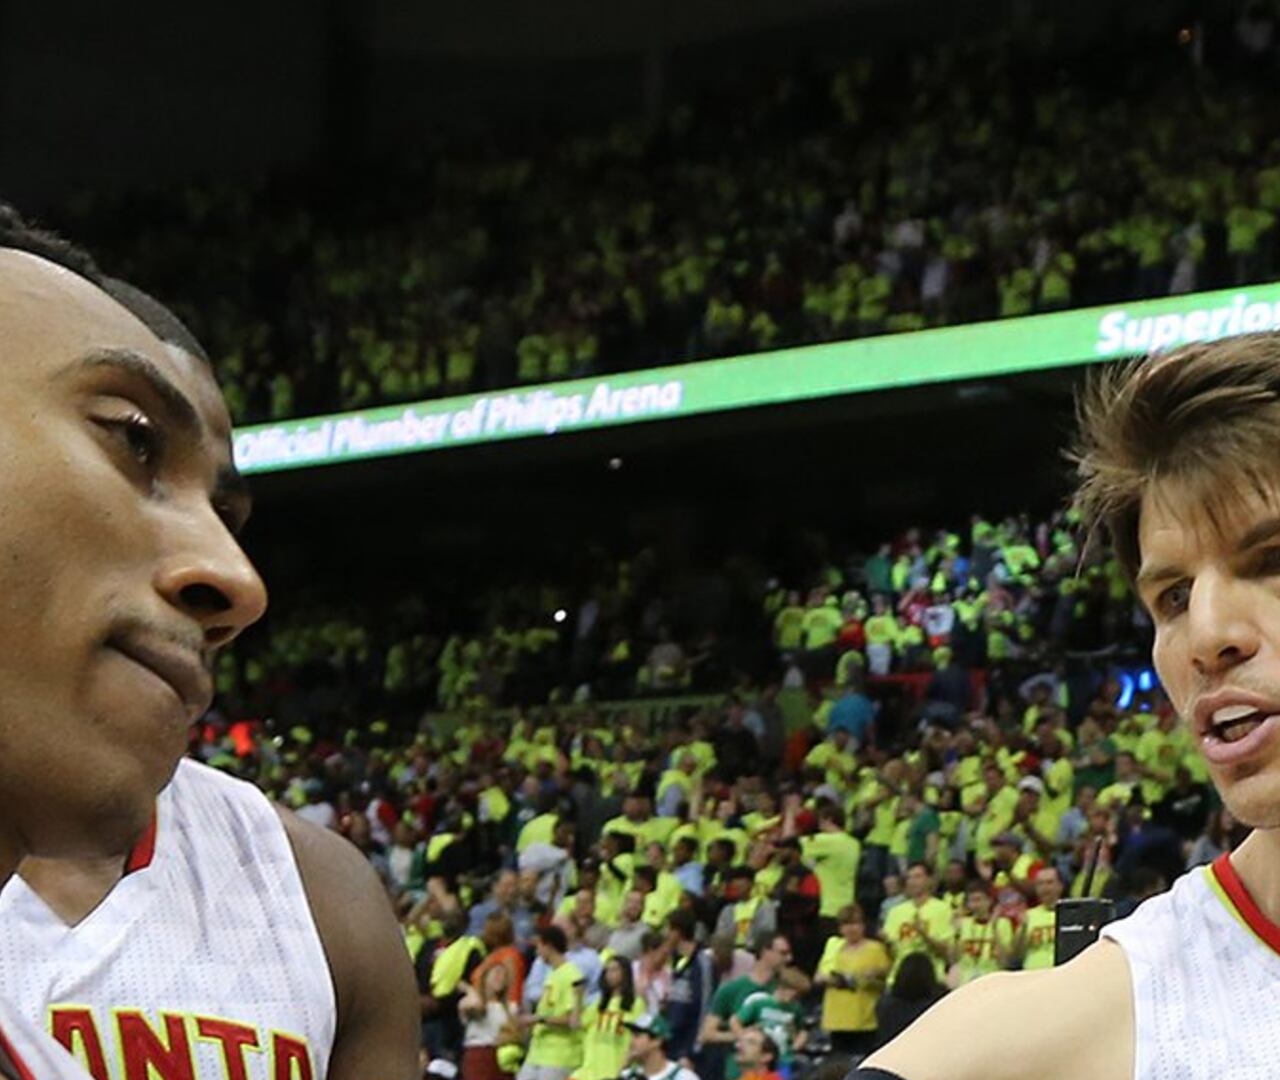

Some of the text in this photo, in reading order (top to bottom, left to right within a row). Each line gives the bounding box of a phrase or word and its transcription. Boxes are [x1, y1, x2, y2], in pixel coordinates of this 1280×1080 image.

[233, 381, 682, 464] Official Plumber of Philips Arena
